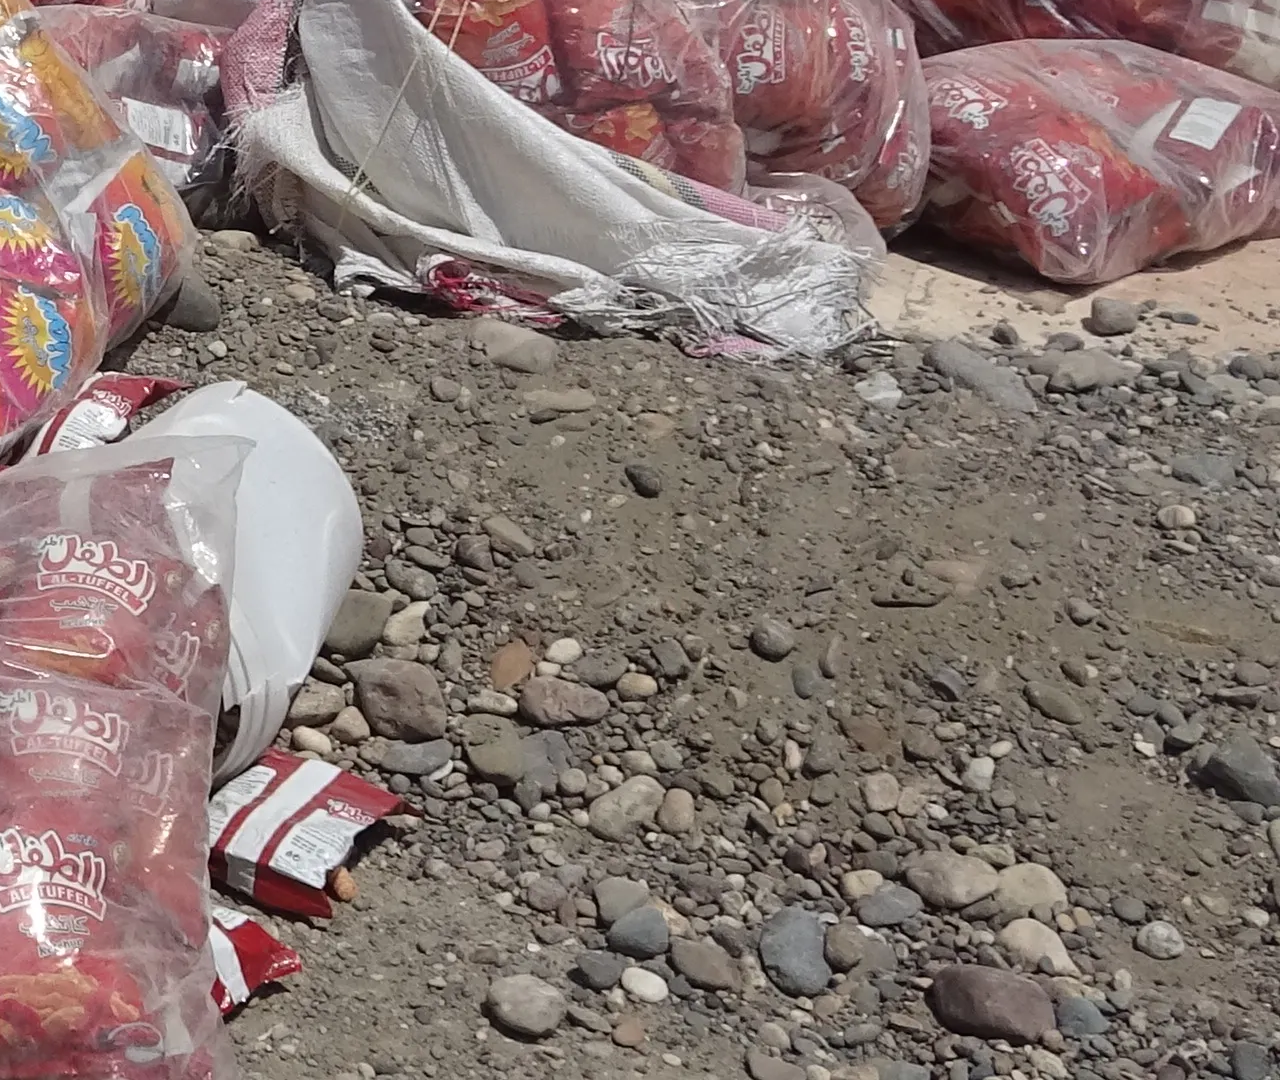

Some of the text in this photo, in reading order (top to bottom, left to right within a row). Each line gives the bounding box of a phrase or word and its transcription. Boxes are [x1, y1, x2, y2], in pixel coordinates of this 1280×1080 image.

[42, 534, 155, 607] الطفل
[51, 573, 130, 603] AL-TUFFEL
[27, 736, 109, 764] AL-TUFFEL
